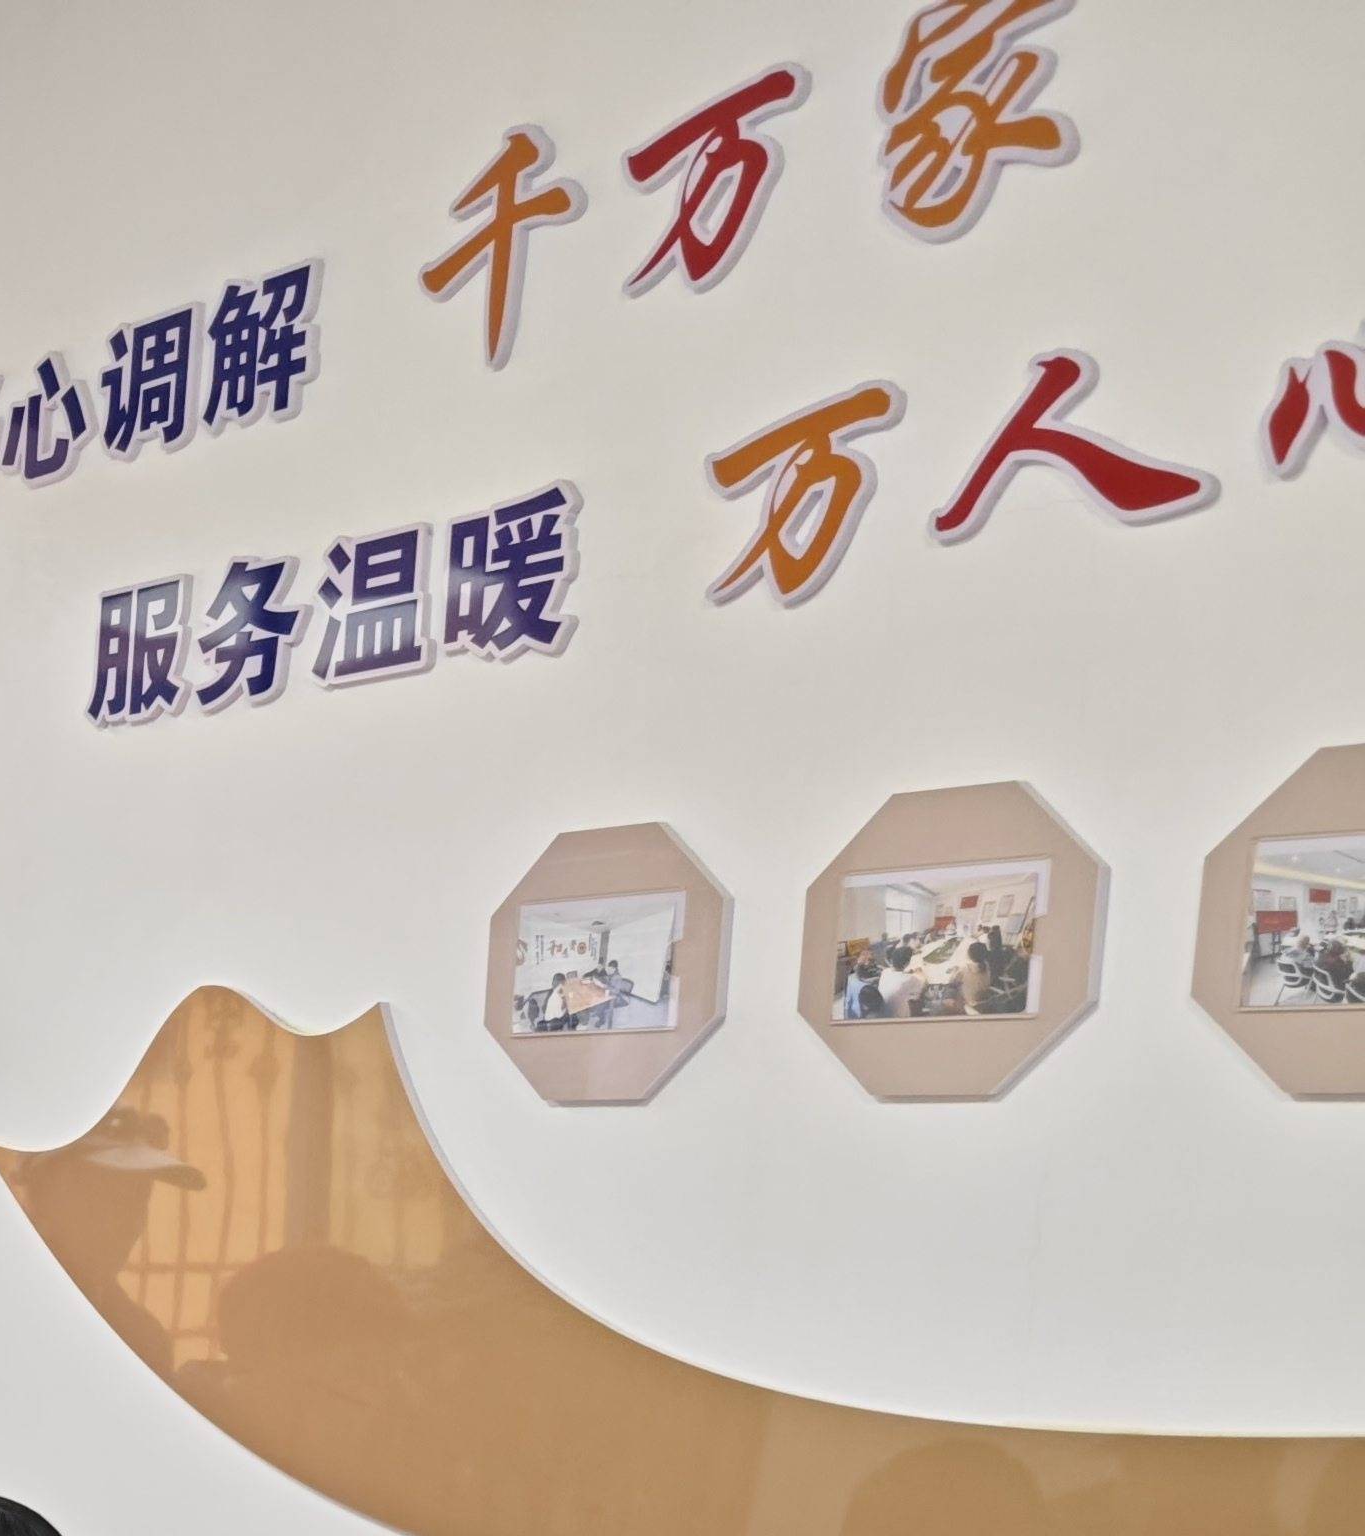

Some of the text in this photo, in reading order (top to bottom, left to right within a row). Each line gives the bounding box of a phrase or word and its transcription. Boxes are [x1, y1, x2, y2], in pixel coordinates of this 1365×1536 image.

[422, 0, 1062, 363] 千万家
[89, 487, 571, 718] 服务温暖
